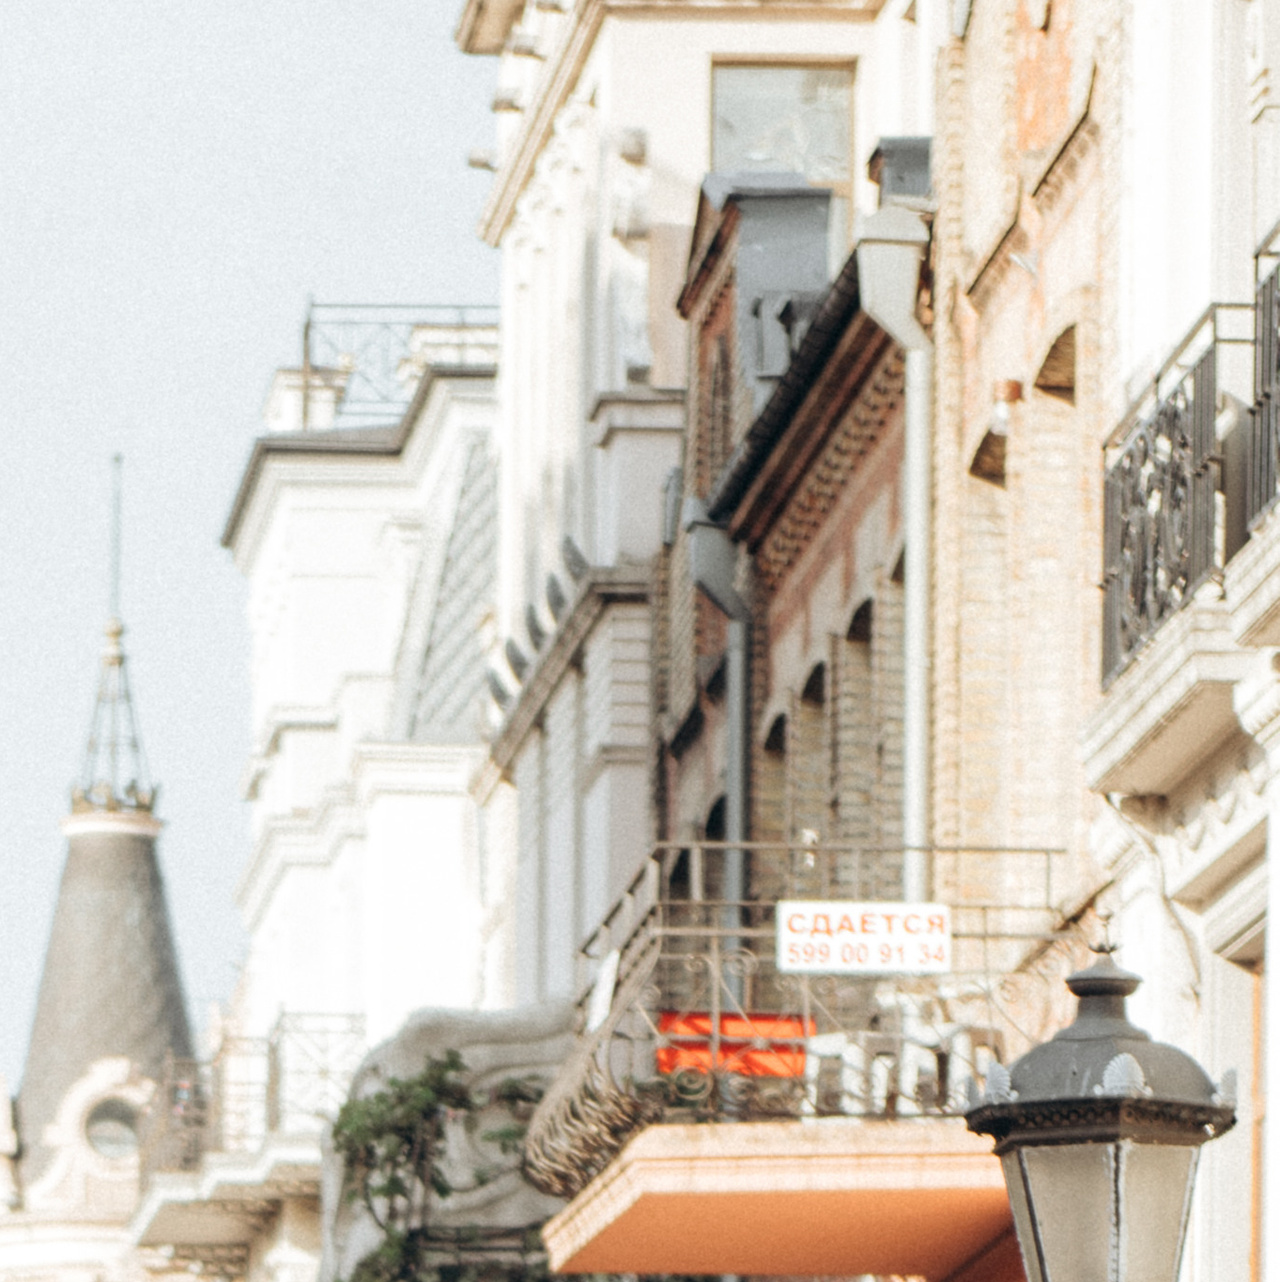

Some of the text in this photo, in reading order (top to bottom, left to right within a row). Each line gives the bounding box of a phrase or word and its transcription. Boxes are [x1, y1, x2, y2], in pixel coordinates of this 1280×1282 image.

[787, 912, 945, 938] СДАЕТСЯ
[788, 942, 945, 964] 599 00 91 34
